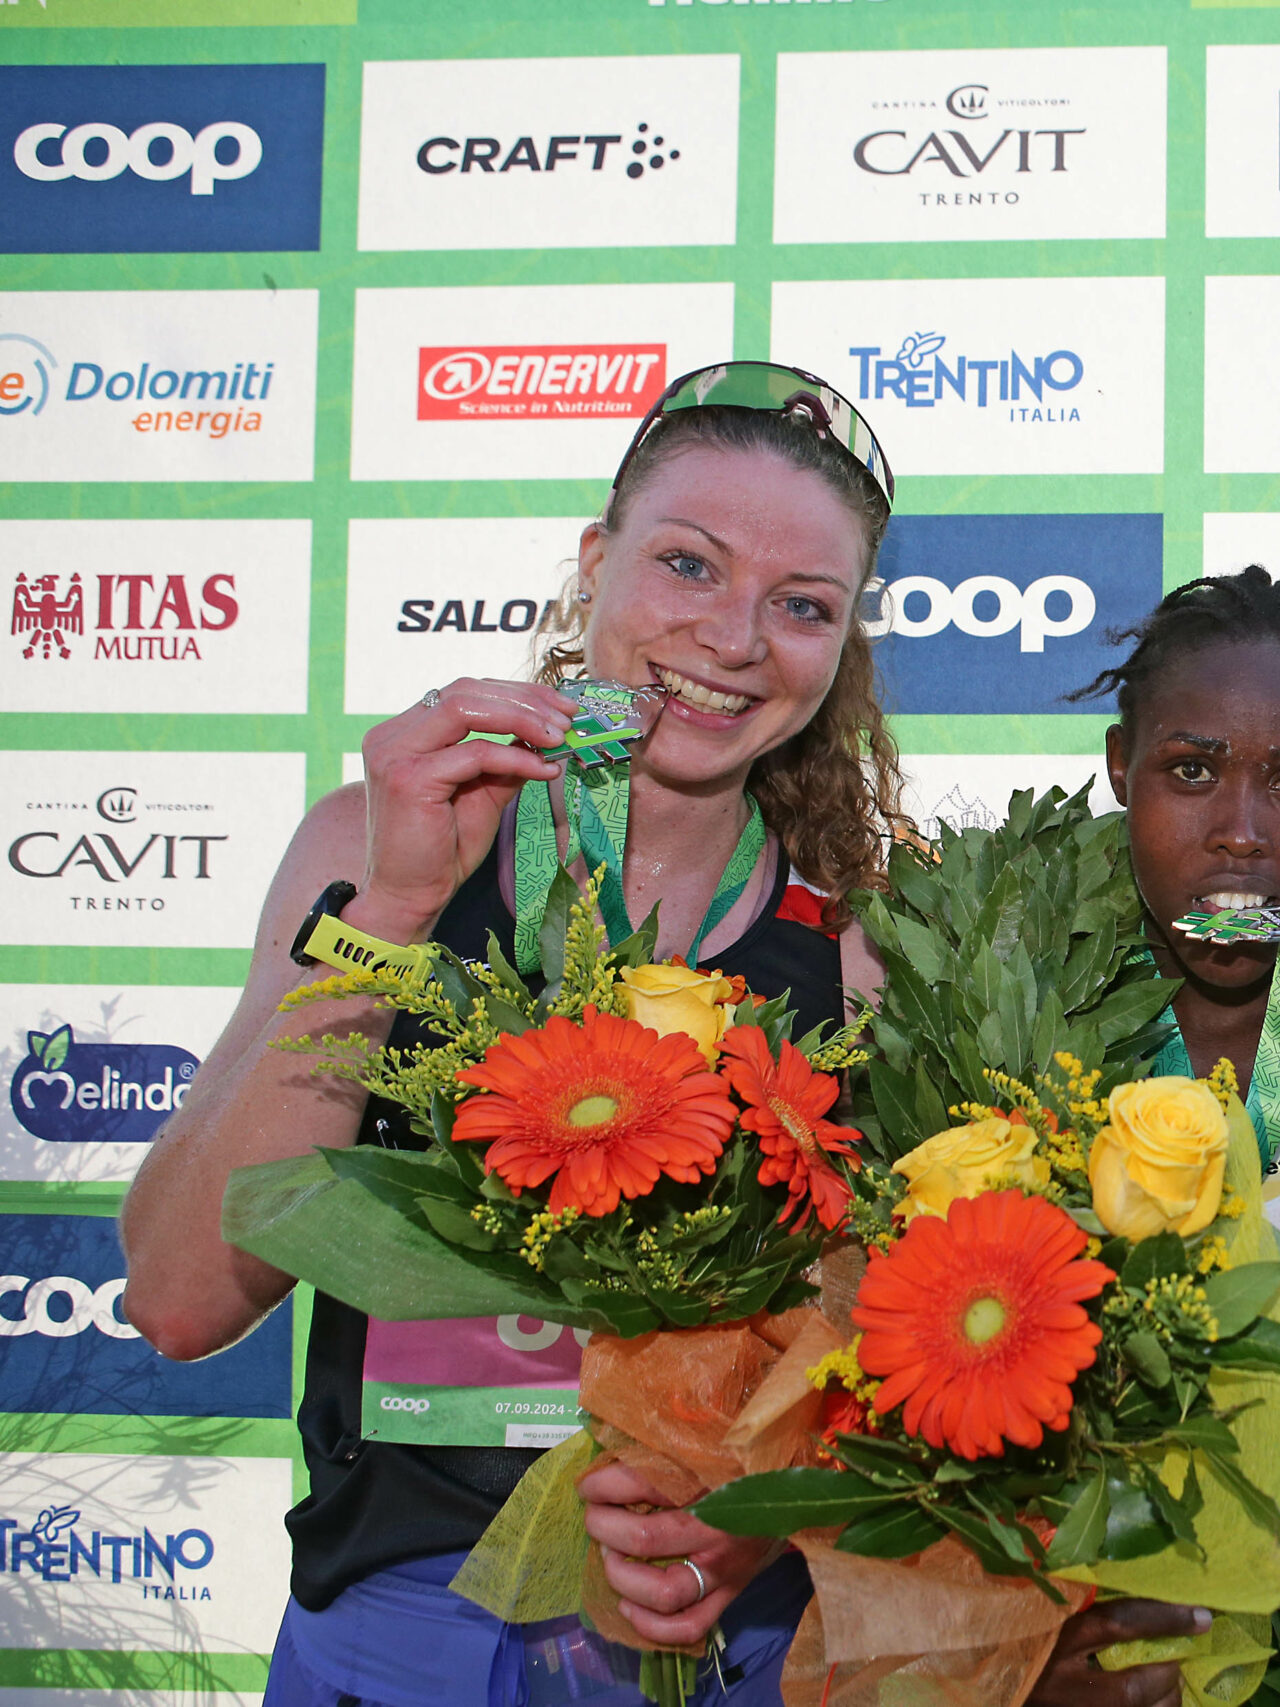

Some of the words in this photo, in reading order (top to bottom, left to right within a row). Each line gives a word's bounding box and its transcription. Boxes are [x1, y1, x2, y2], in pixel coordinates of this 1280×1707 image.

[871, 101, 937, 109] CANTINA
[998, 98, 1071, 107] VITICOLTORI
[14, 121, 263, 195] coop
[416, 135, 622, 175] CRAFT
[853, 128, 1087, 178] CAVIT
[918, 192, 1020, 206] TRENTO
[65, 362, 275, 401] Dolomiti
[485, 353, 660, 396] ENERVIT
[849, 347, 1084, 408] TRENTINO
[458, 401, 528, 415] Science
[530, 400, 548, 414] in
[552, 400, 632, 414] Nutrition
[1009, 407, 1081, 423] ITALIA
[131, 406, 262, 440] energia
[94, 573, 240, 631] ITAS
[397, 599, 552, 633] SALO
[94, 636, 203, 661] MUTUA
[26, 802, 89, 810] CANTINA
[146, 803, 215, 812] VITICOLTORI
[8, 831, 230, 883] CAVIT
[70, 897, 166, 911] TRENTO
[380, 1396, 430, 1414] coop
[495, 1402, 566, 1415] 07.09.2024
[143, 1585, 212, 1601] ITALIA
